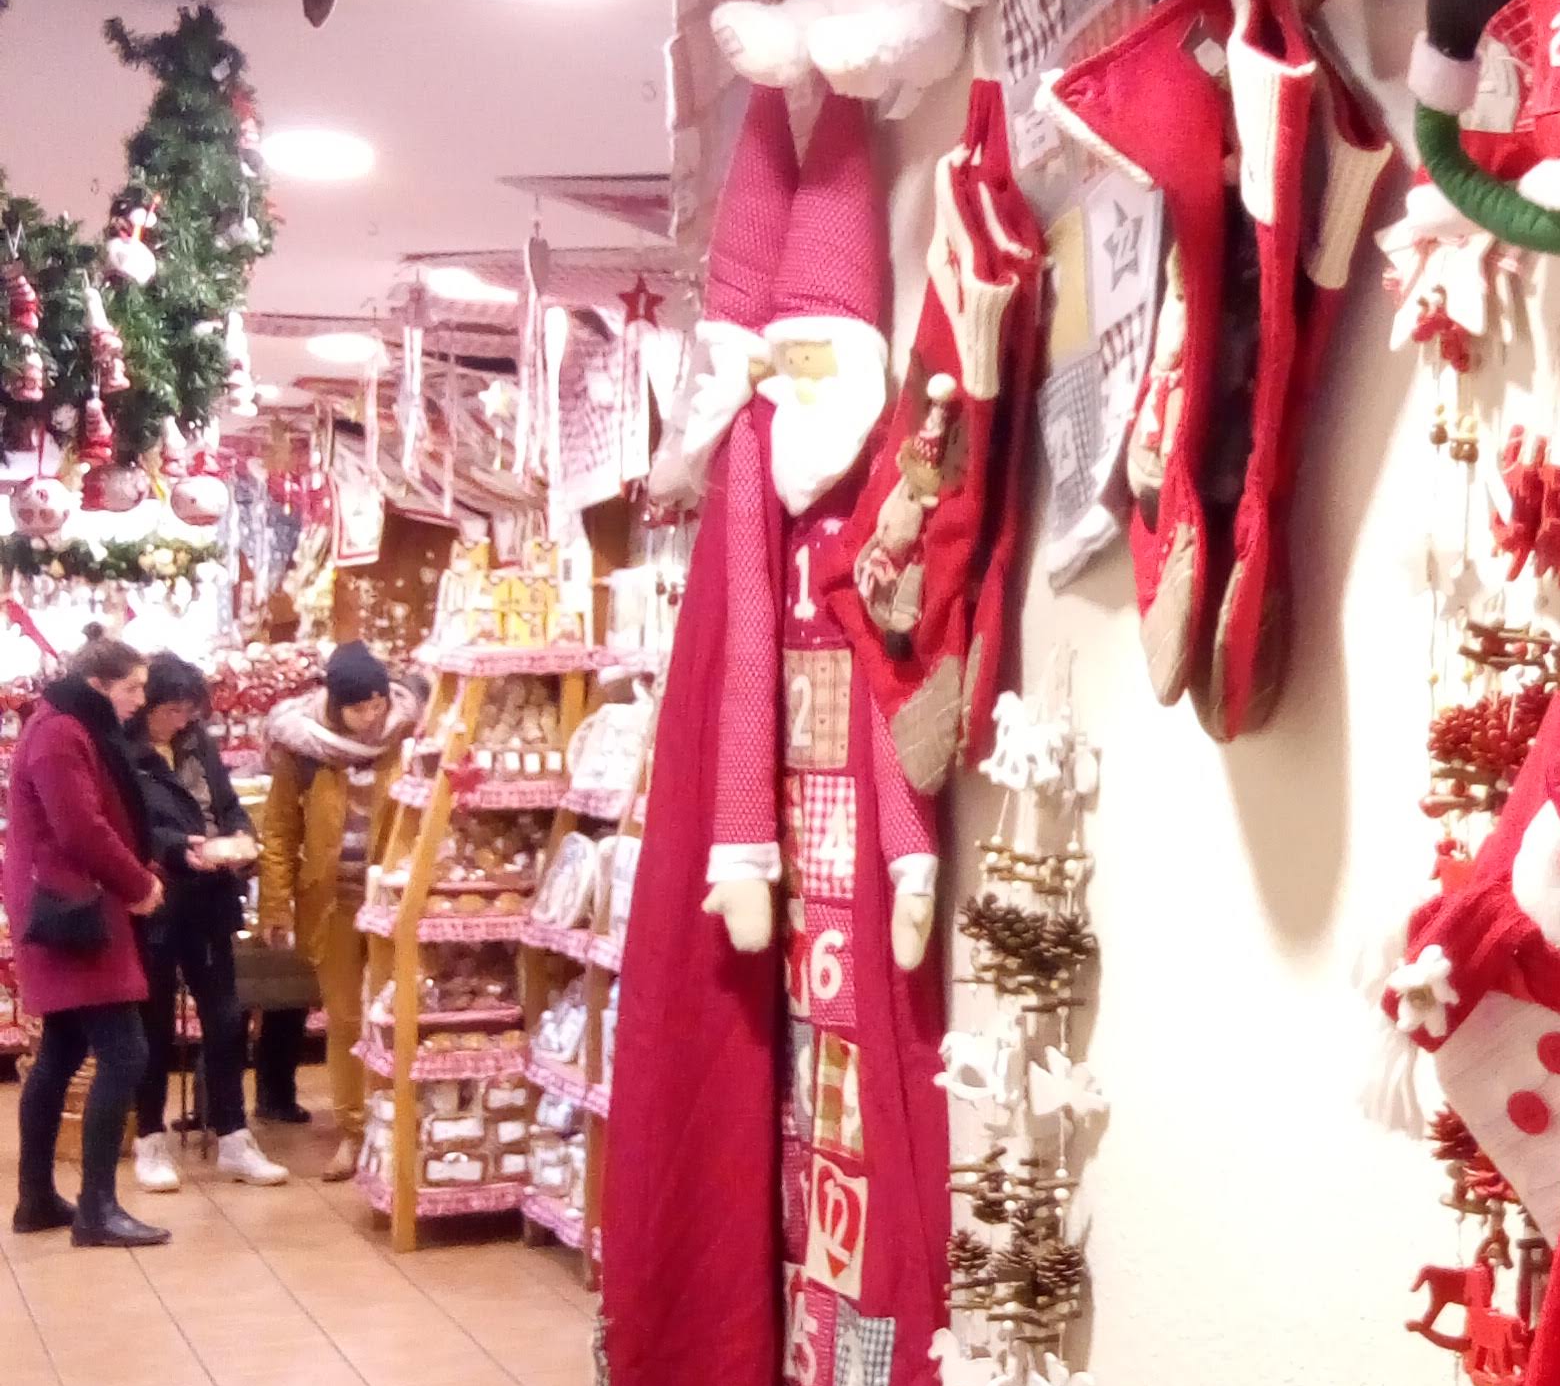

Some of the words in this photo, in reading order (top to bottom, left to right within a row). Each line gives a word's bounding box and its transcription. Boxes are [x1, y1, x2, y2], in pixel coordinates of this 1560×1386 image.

[794, 544, 817, 621] 1
[790, 674, 813, 747] 2
[819, 801, 856, 878] 4
[810, 928, 845, 1001] 6
